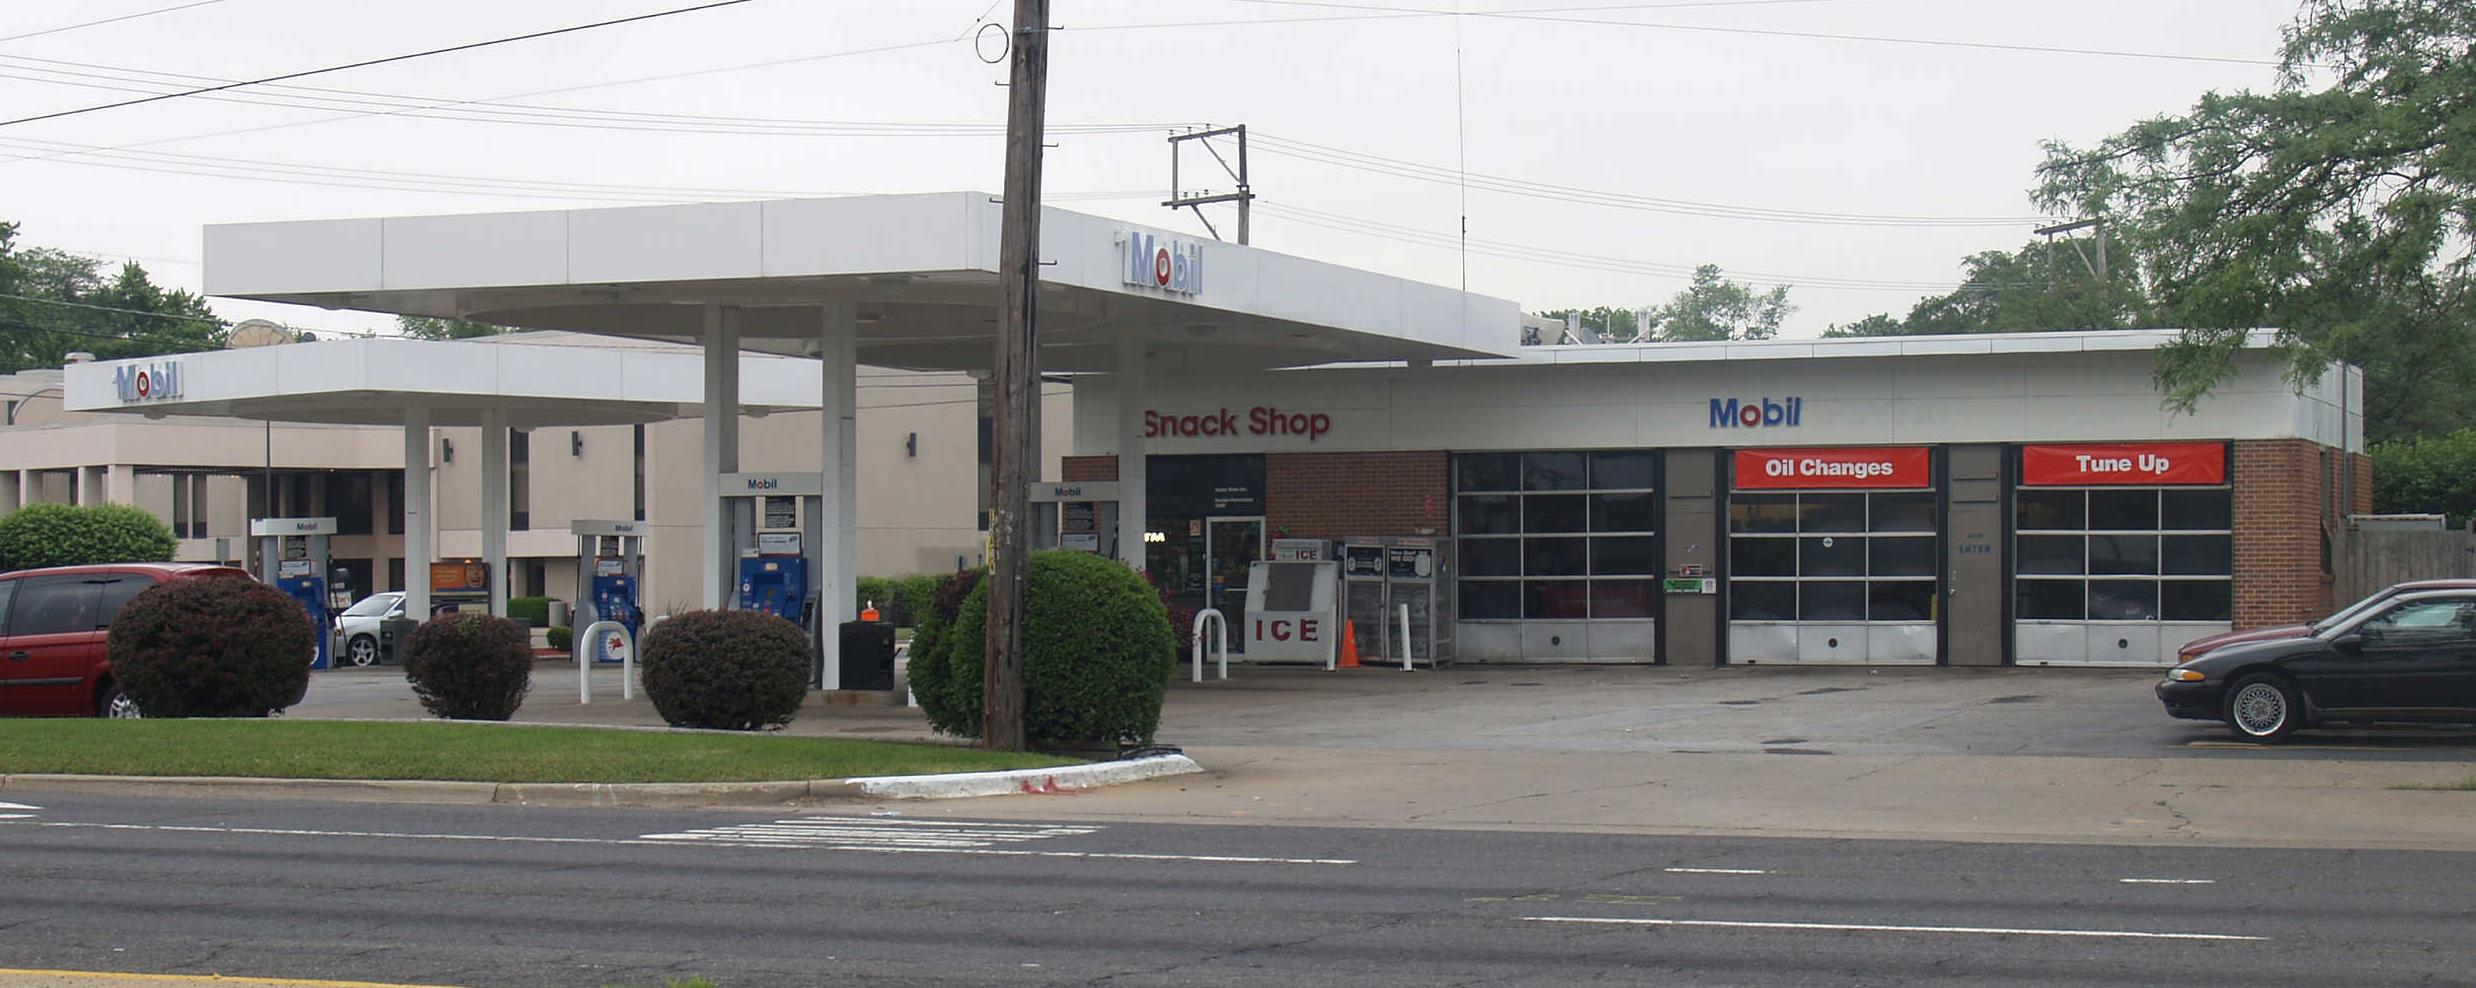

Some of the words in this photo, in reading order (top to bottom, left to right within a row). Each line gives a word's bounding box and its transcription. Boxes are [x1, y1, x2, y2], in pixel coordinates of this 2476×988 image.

[1131, 232, 1203, 296] Mobil
[116, 361, 179, 400] Mobil
[1710, 397, 1802, 428] Mobil
[1145, 408, 1239, 438] Snack
[1248, 406, 1331, 443] Shop
[1765, 459, 1795, 477] Oil
[1800, 459, 1893, 479] Changes
[2075, 455, 2132, 472] Tune
[2138, 454, 2170, 475] Up
[747, 479, 778, 489] Mobil
[1055, 487, 1081, 496] Mobil
[296, 523, 318, 531] Mobil
[1296, 550, 1318, 560] ICE
[1255, 619, 1319, 642] ICE
